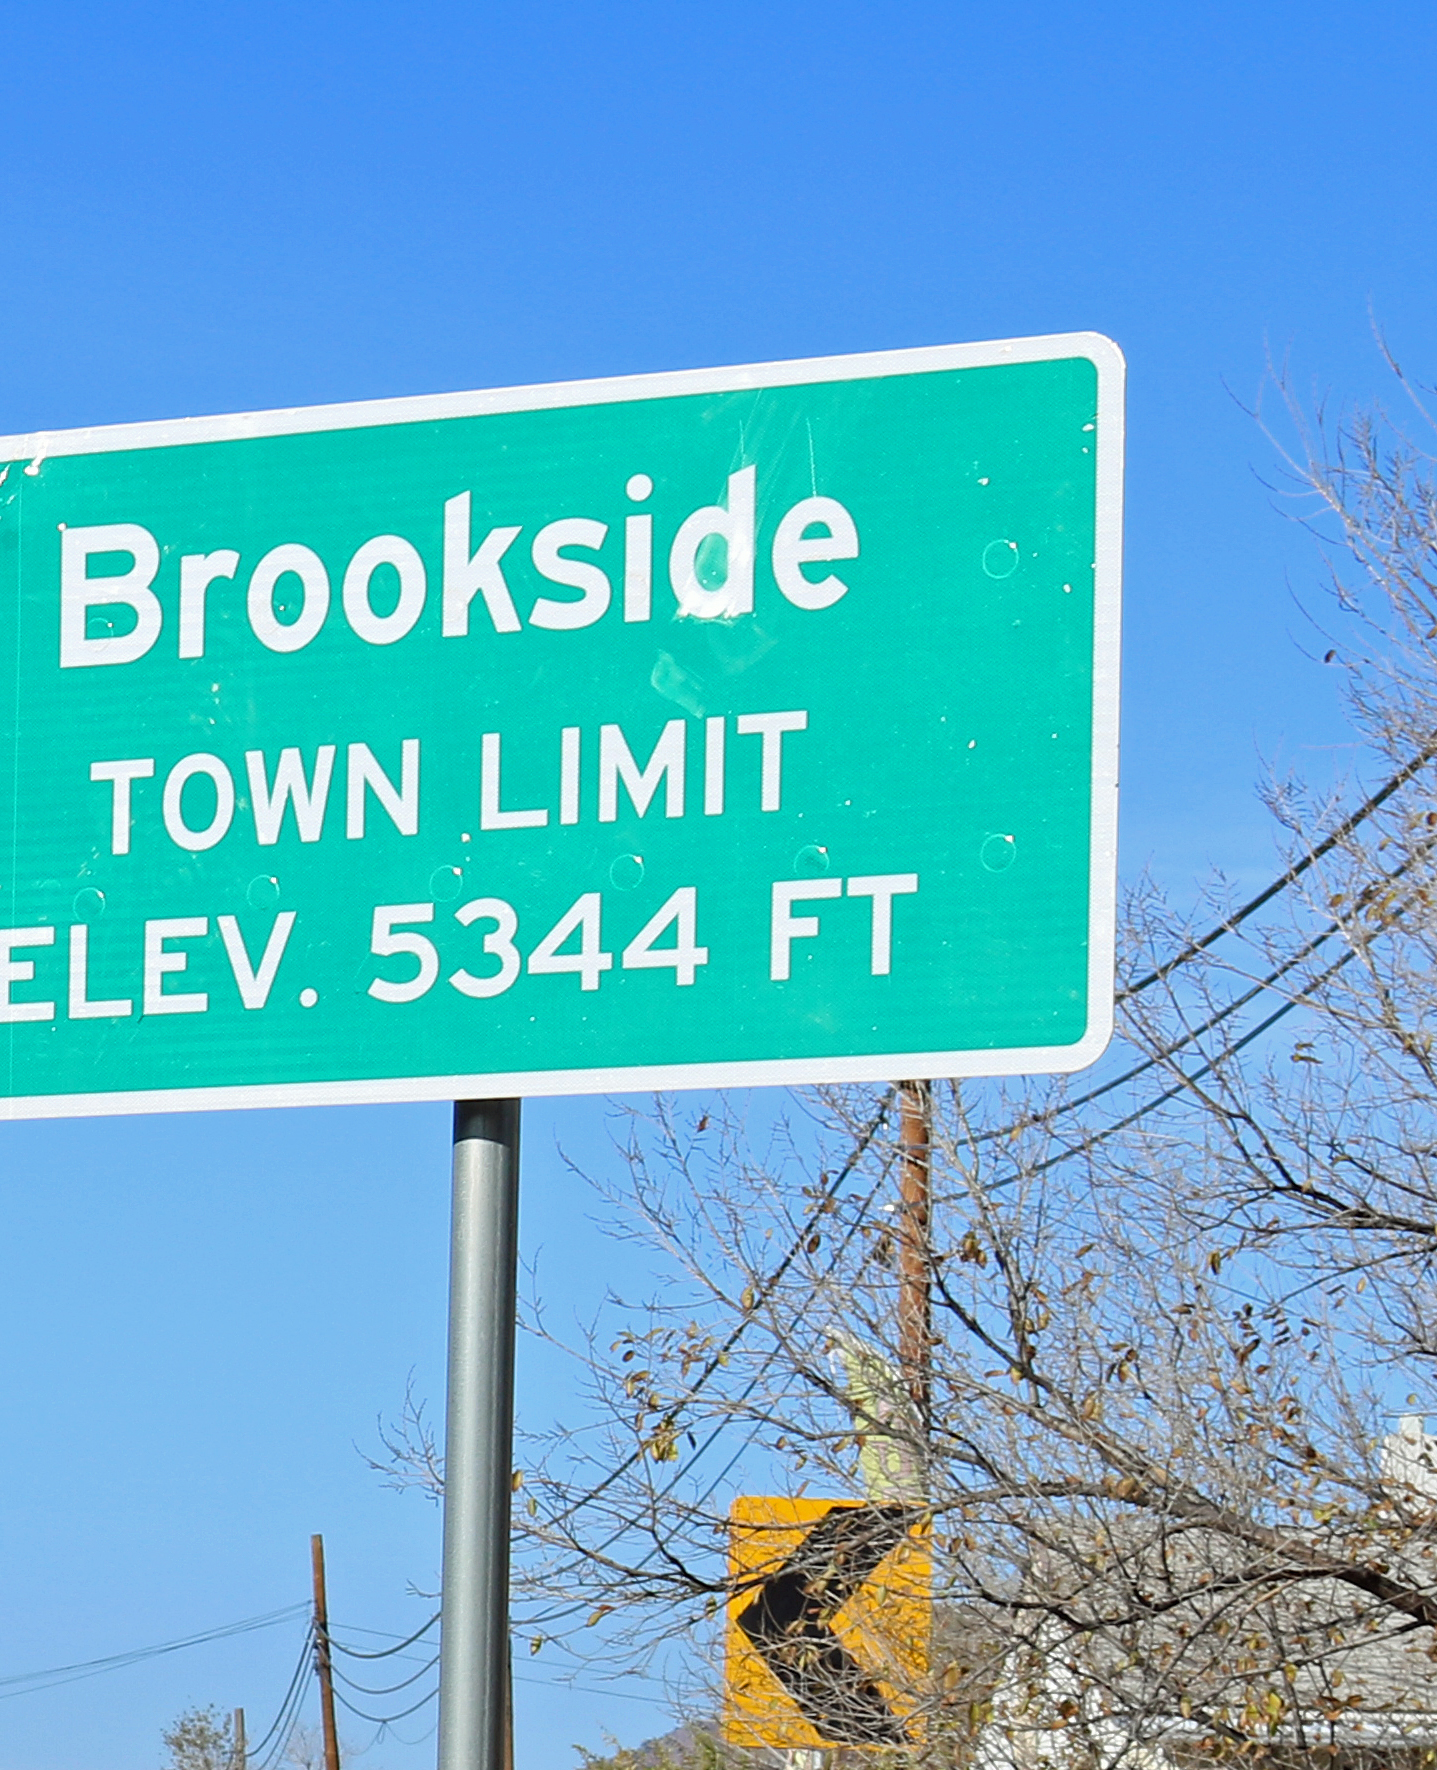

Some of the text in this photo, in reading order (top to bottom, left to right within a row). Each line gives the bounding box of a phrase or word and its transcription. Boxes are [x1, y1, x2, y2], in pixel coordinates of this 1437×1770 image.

[58, 465, 858, 667] Brookside
[91, 711, 807, 854] TOWN LIMIT
[368, 887, 708, 1002] 5344
[771, 874, 917, 980] FT
